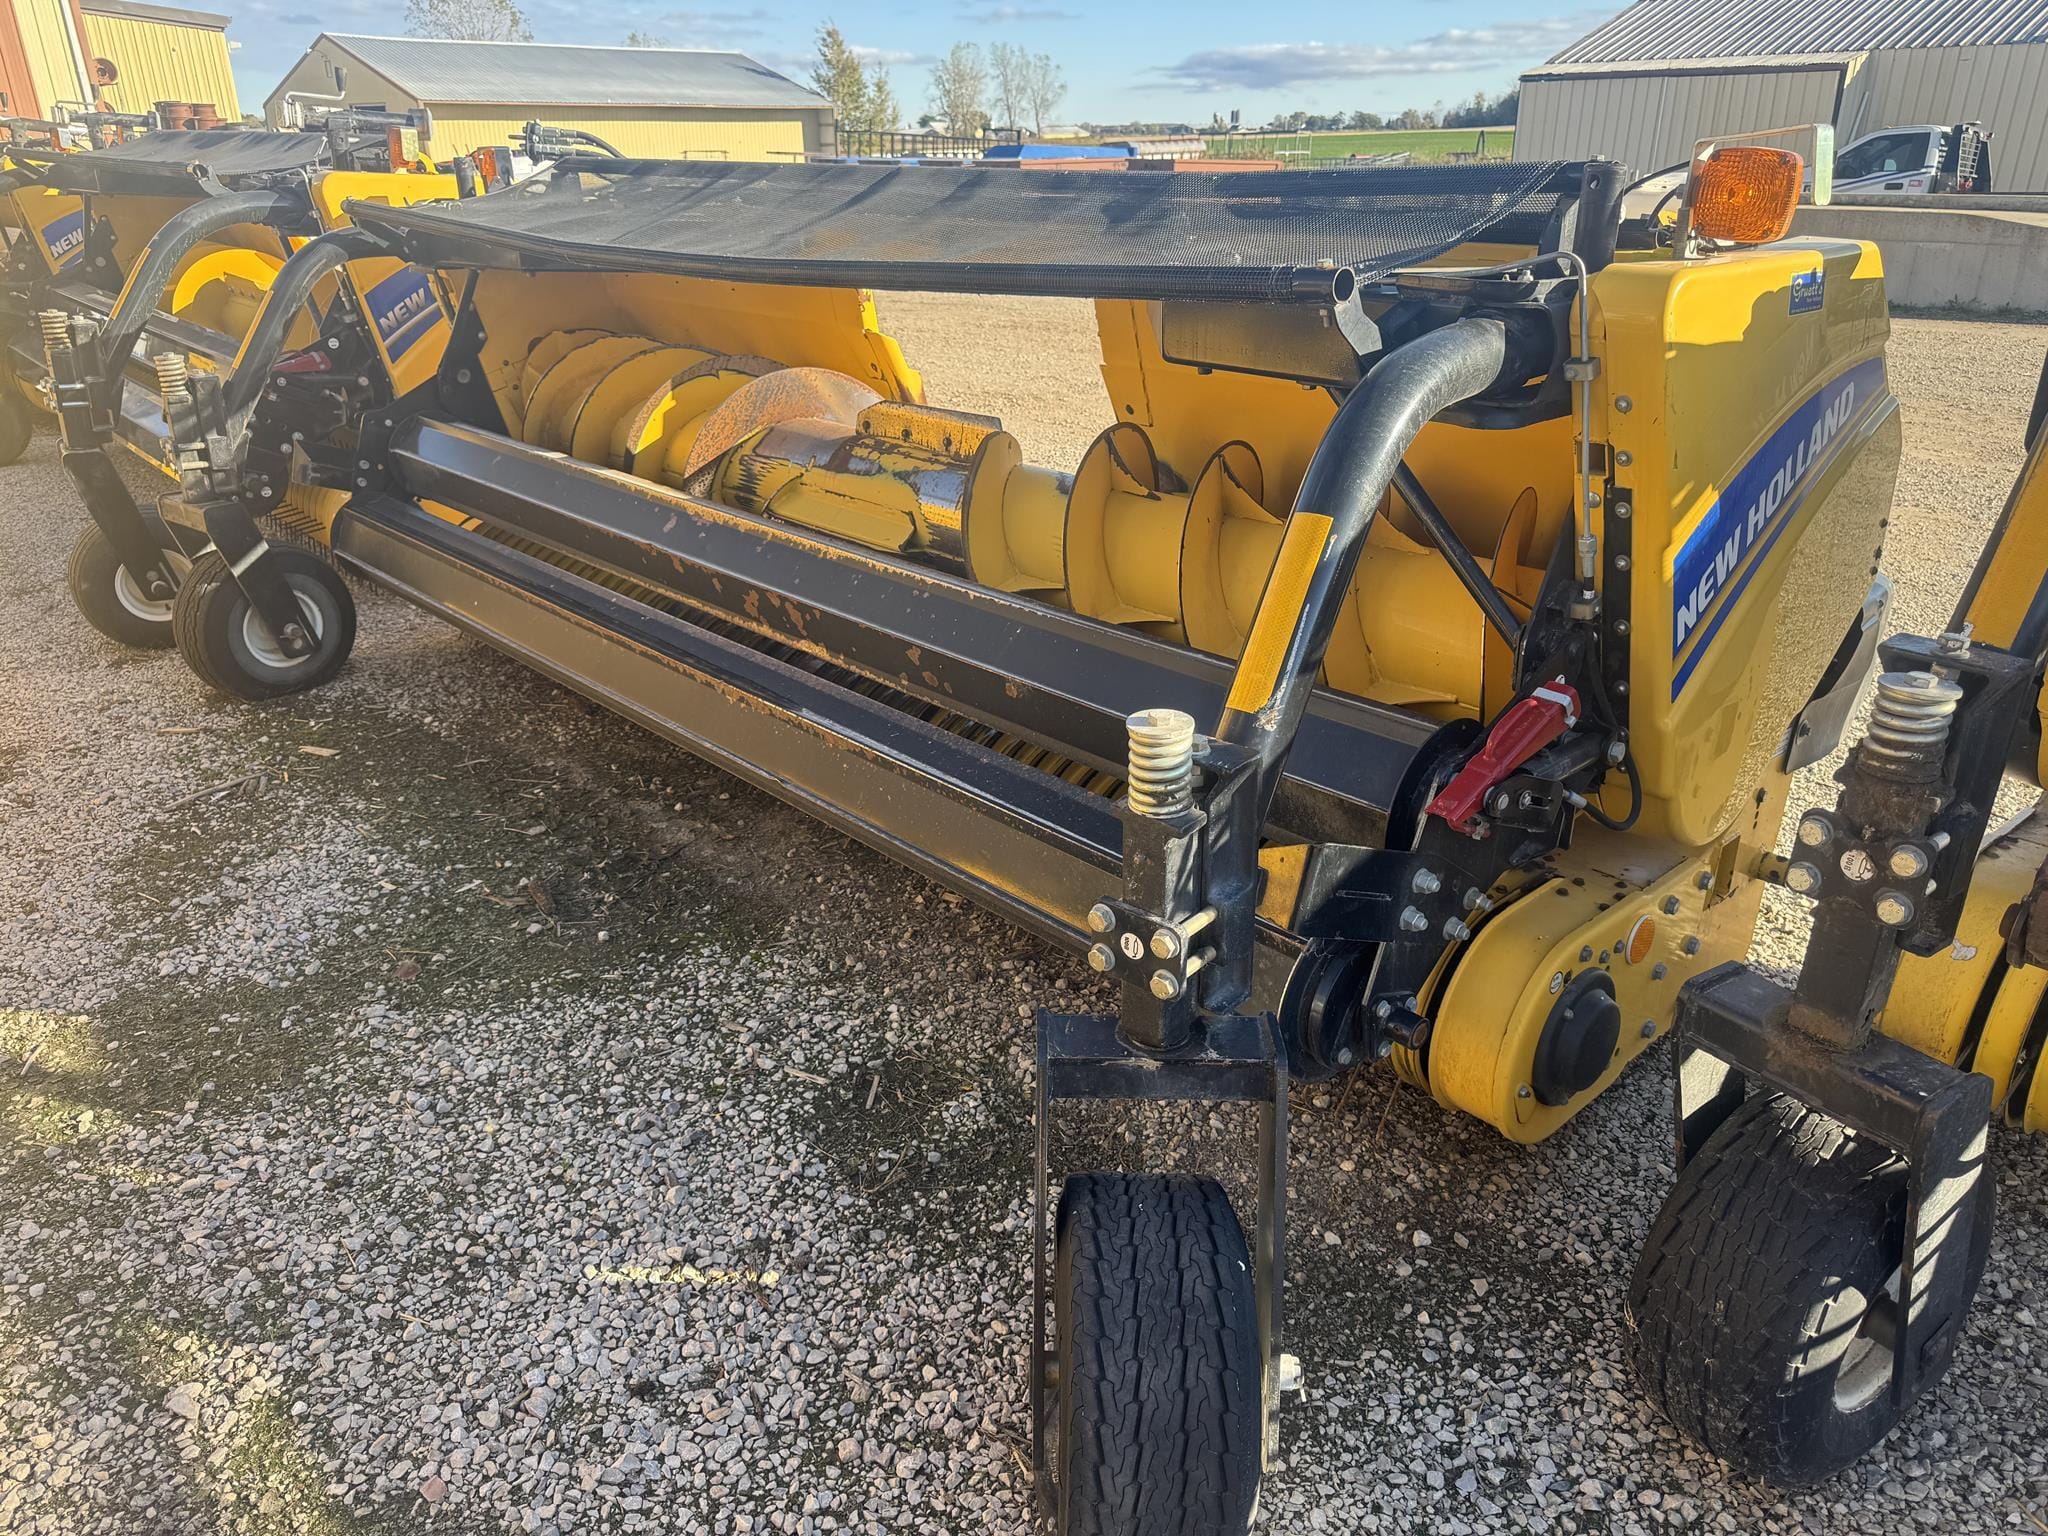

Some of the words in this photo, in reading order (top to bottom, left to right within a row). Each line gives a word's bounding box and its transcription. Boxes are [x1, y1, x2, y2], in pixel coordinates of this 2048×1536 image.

[50, 228, 84, 258] NEW
[379, 287, 426, 334] NEW
[1677, 523, 1742, 648] NEW
[1747, 381, 1855, 548] HOLLAND
